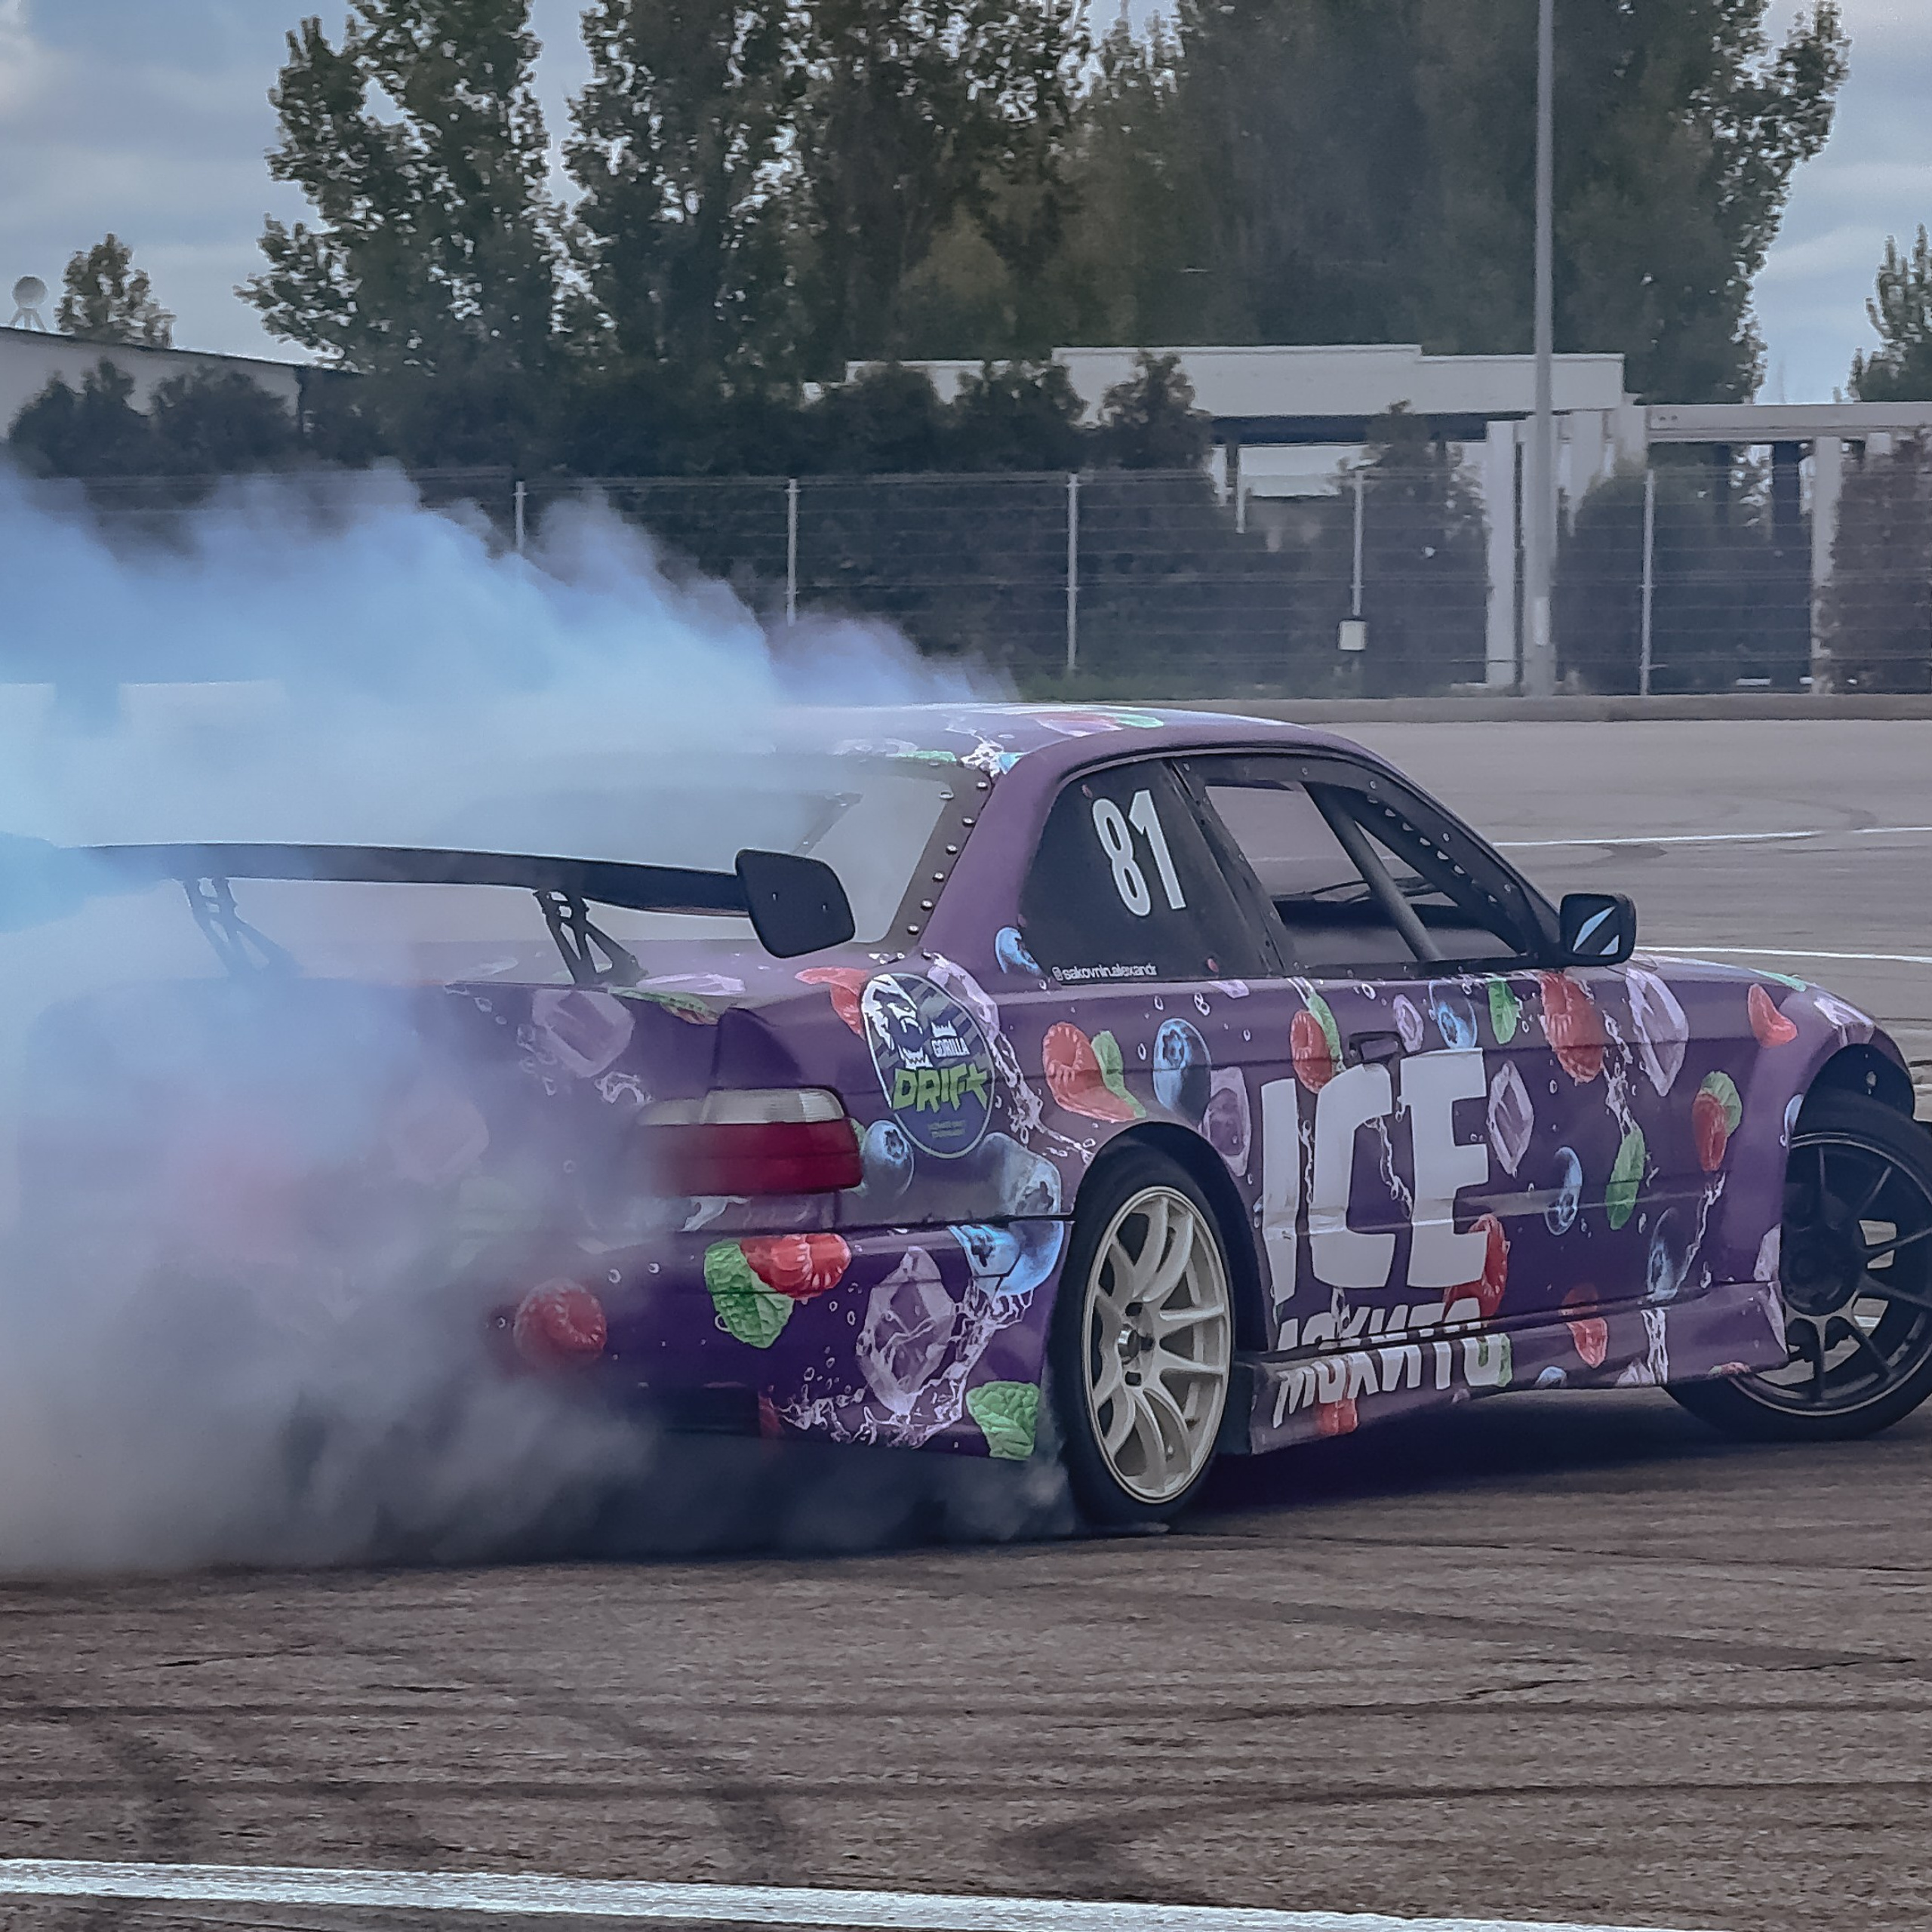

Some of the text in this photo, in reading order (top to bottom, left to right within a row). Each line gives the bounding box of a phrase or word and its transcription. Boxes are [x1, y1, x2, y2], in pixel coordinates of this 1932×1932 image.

[1092, 789, 1186, 917] 81
[893, 1063, 988, 1113] DRIFT
[931, 1037, 971, 1058] GORILLA
[1261, 1048, 1489, 1307] ICE
